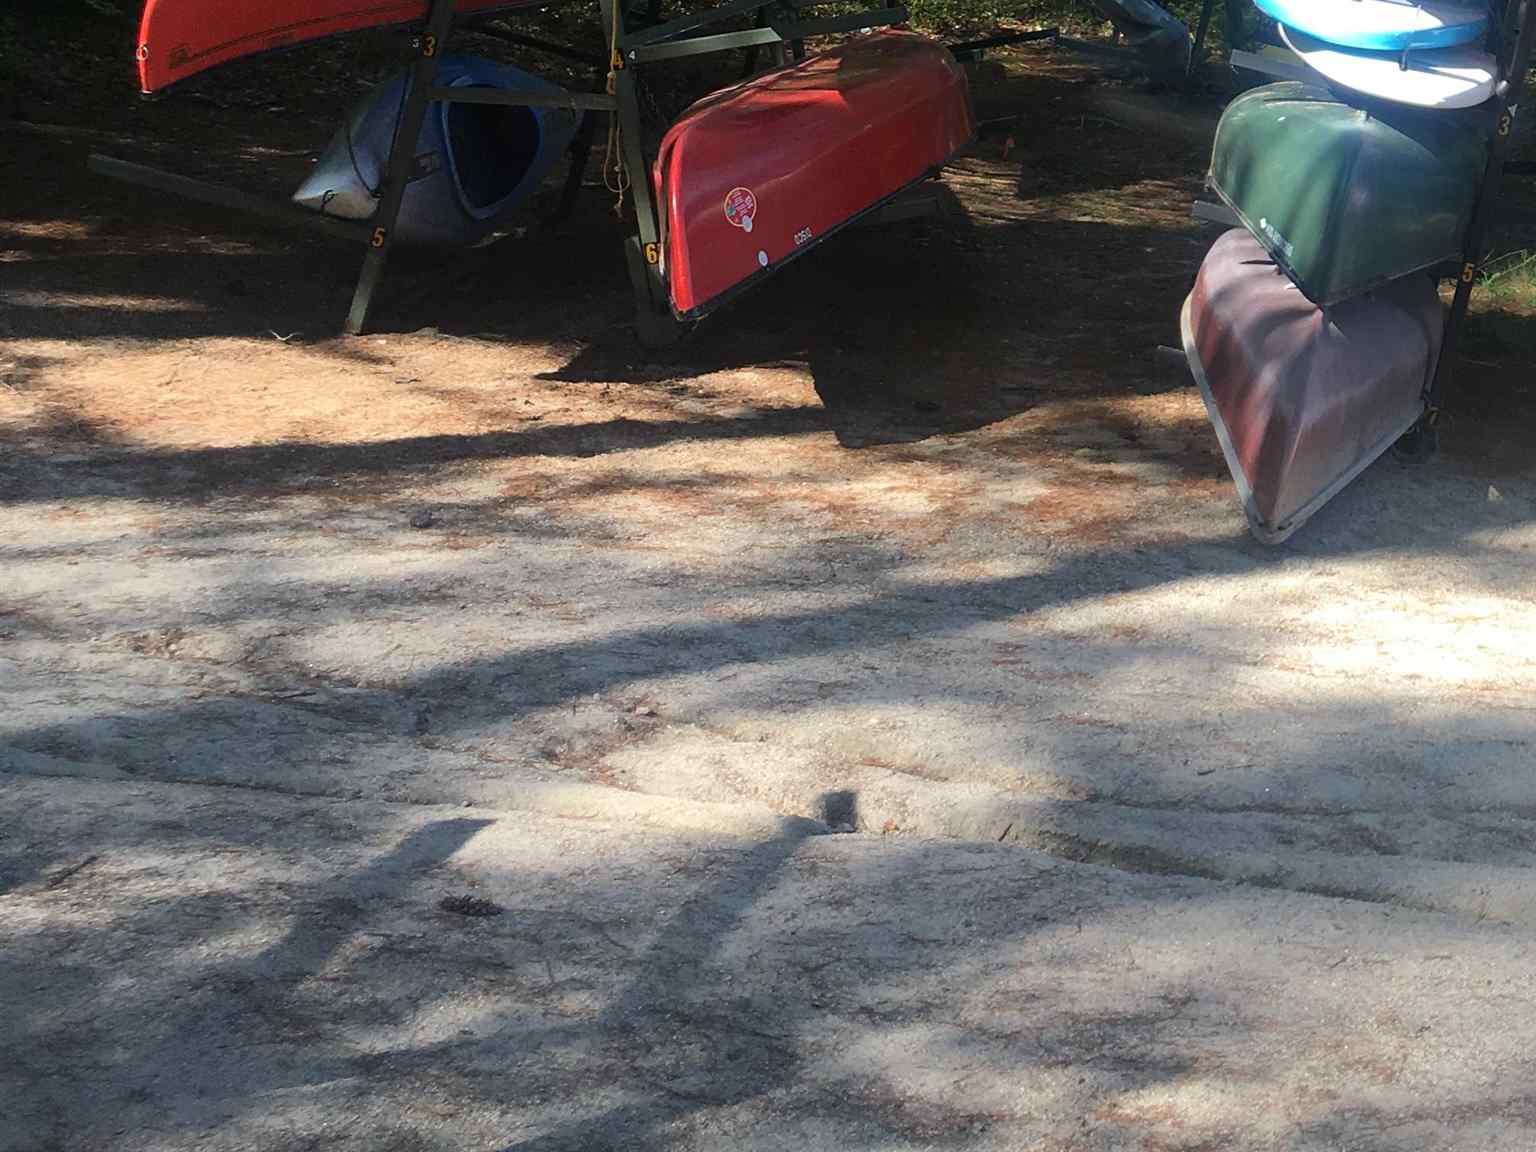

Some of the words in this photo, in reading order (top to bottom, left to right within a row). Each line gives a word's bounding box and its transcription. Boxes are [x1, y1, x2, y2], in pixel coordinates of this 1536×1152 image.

[423, 35, 436, 56] 3
[628, 50, 636, 60] 4
[1498, 116, 1510, 135] 3
[371, 227, 385, 247] 5
[646, 243, 658, 264] 6
[1462, 262, 1475, 282] 5
